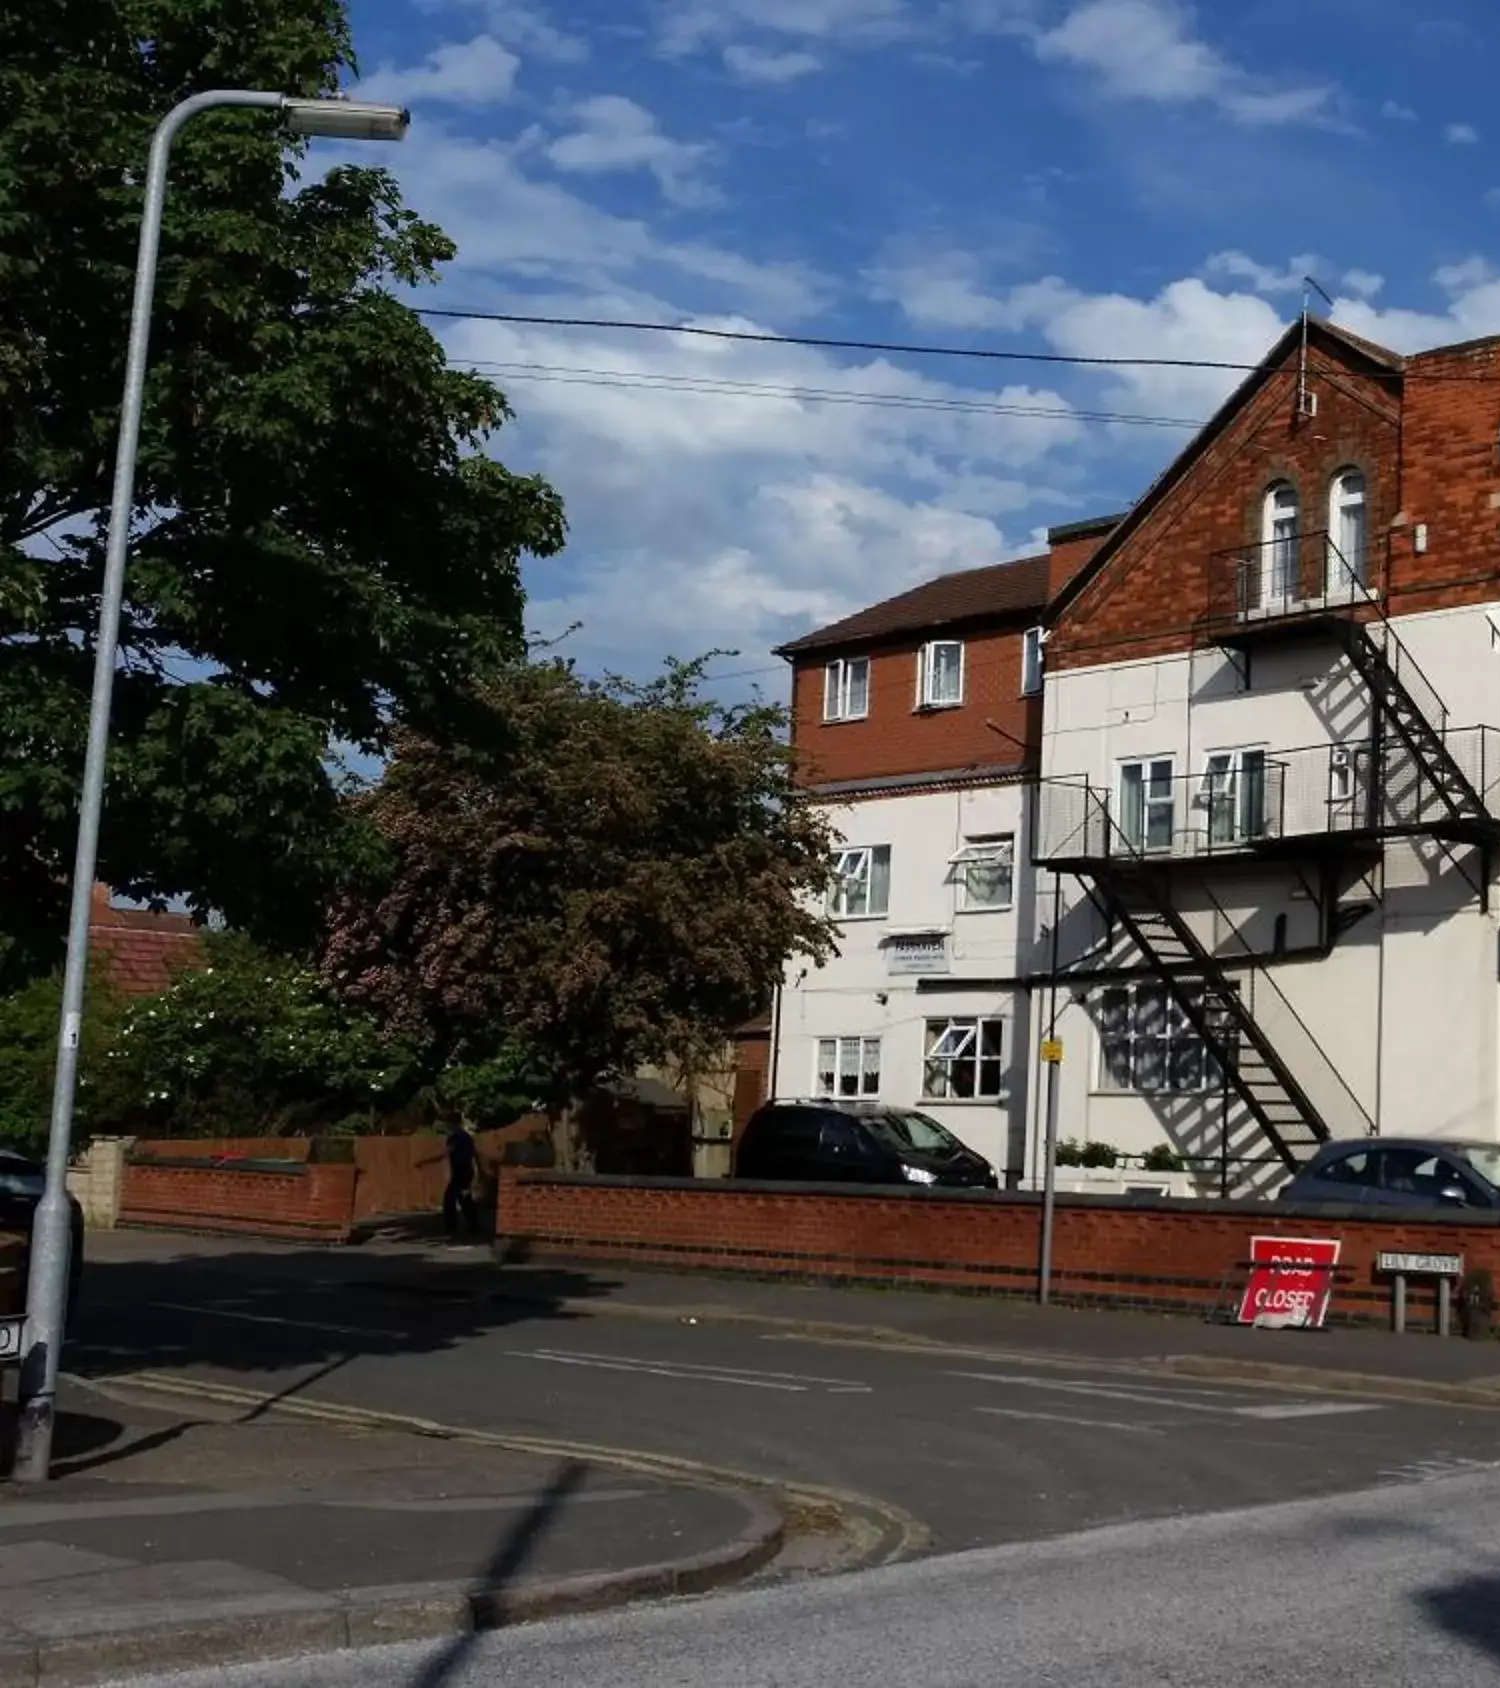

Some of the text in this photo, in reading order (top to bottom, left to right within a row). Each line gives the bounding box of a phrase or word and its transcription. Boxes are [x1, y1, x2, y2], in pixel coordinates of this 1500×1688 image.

[1385, 1254, 1458, 1271] LILY GROVE
[1254, 1287, 1316, 1310] CLOSED
